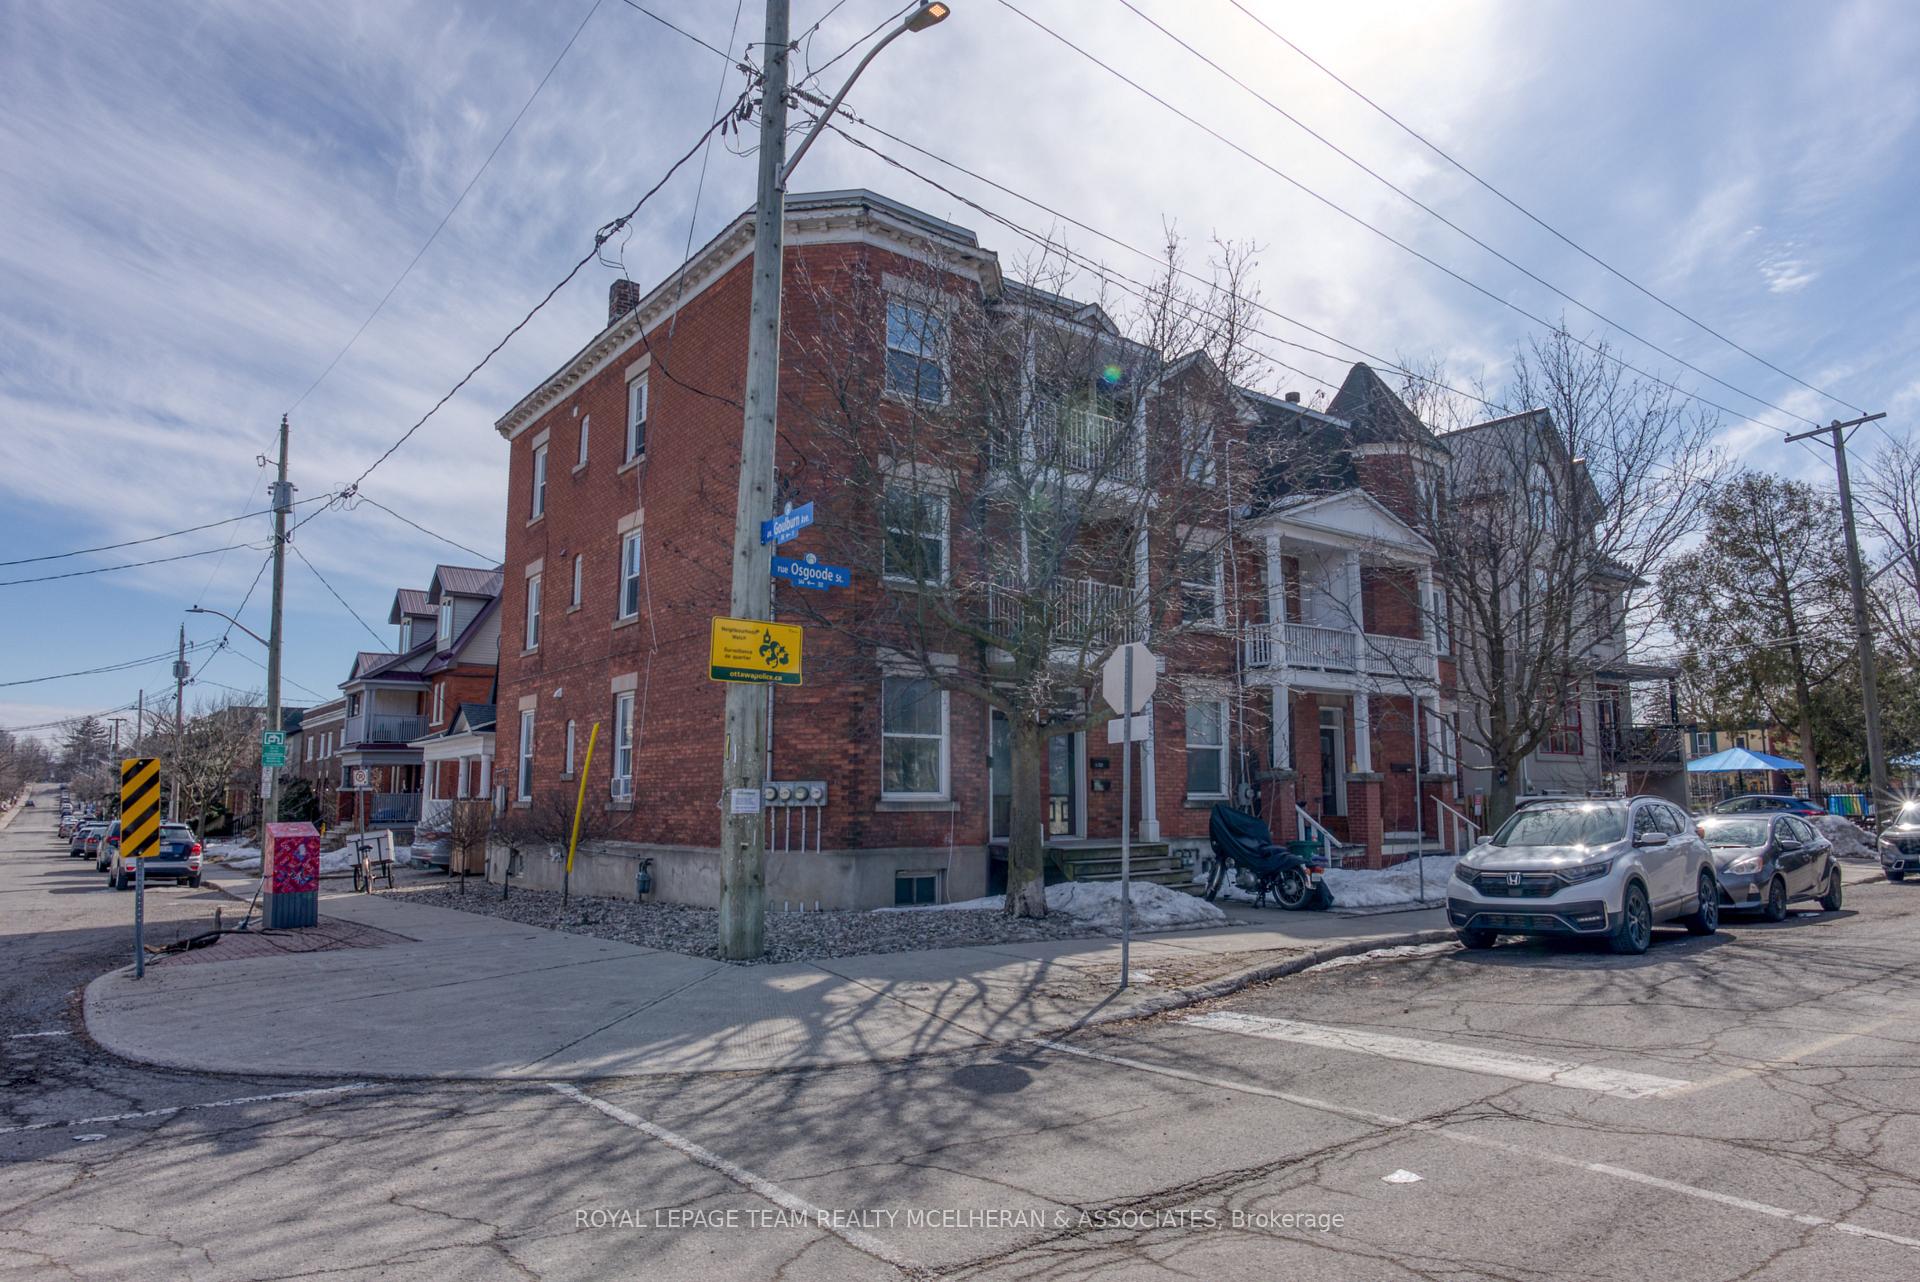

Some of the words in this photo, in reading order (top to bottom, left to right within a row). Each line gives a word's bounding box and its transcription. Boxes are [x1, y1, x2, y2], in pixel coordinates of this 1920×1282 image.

[773, 515, 800, 535] Goulburn
[777, 565, 788, 574] rue
[791, 563, 833, 581] Osgoode
[835, 574, 844, 583] St.
[729, 671, 783, 681] ottawapolice.ca
